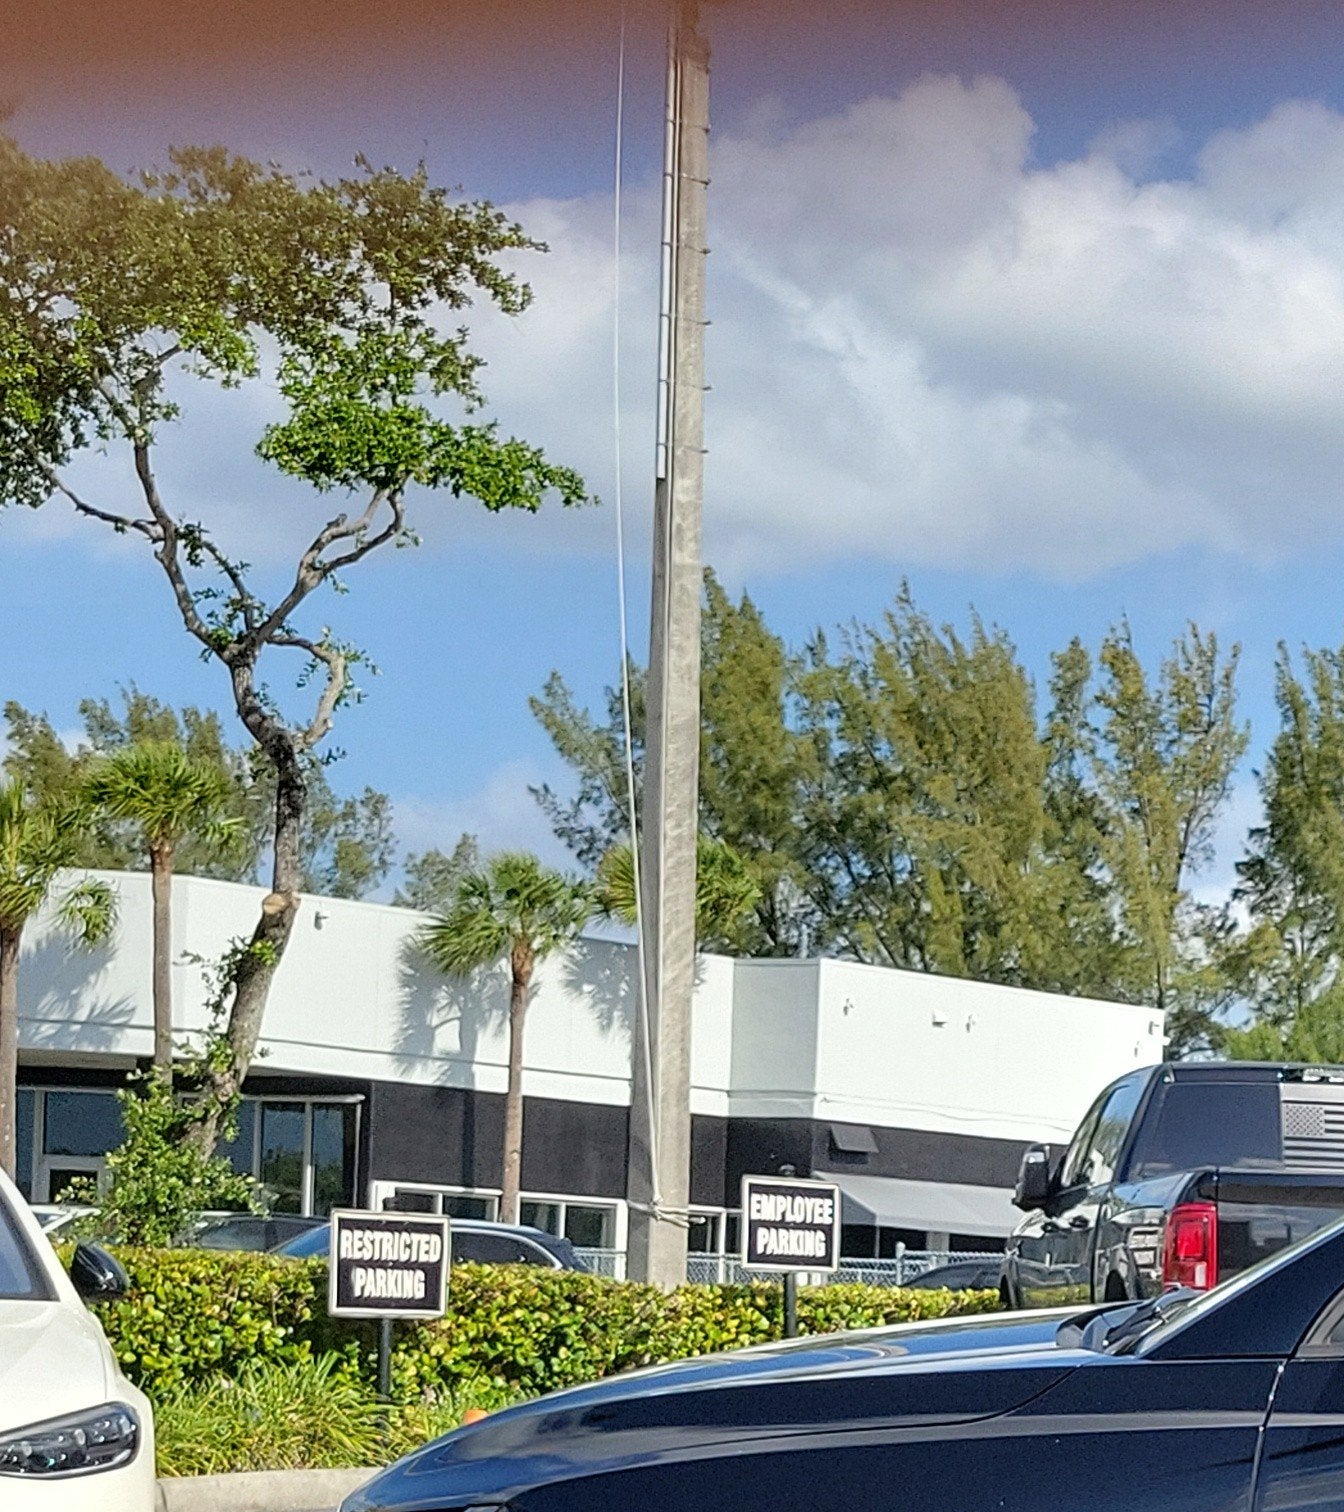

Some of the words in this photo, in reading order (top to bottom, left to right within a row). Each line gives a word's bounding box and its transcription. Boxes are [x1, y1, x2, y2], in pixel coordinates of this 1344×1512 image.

[750, 1192, 834, 1225] EMPLOYEE
[340, 1229, 442, 1264] RESTRICTED
[756, 1228, 827, 1258] PARKING
[353, 1267, 426, 1299] PARKING
